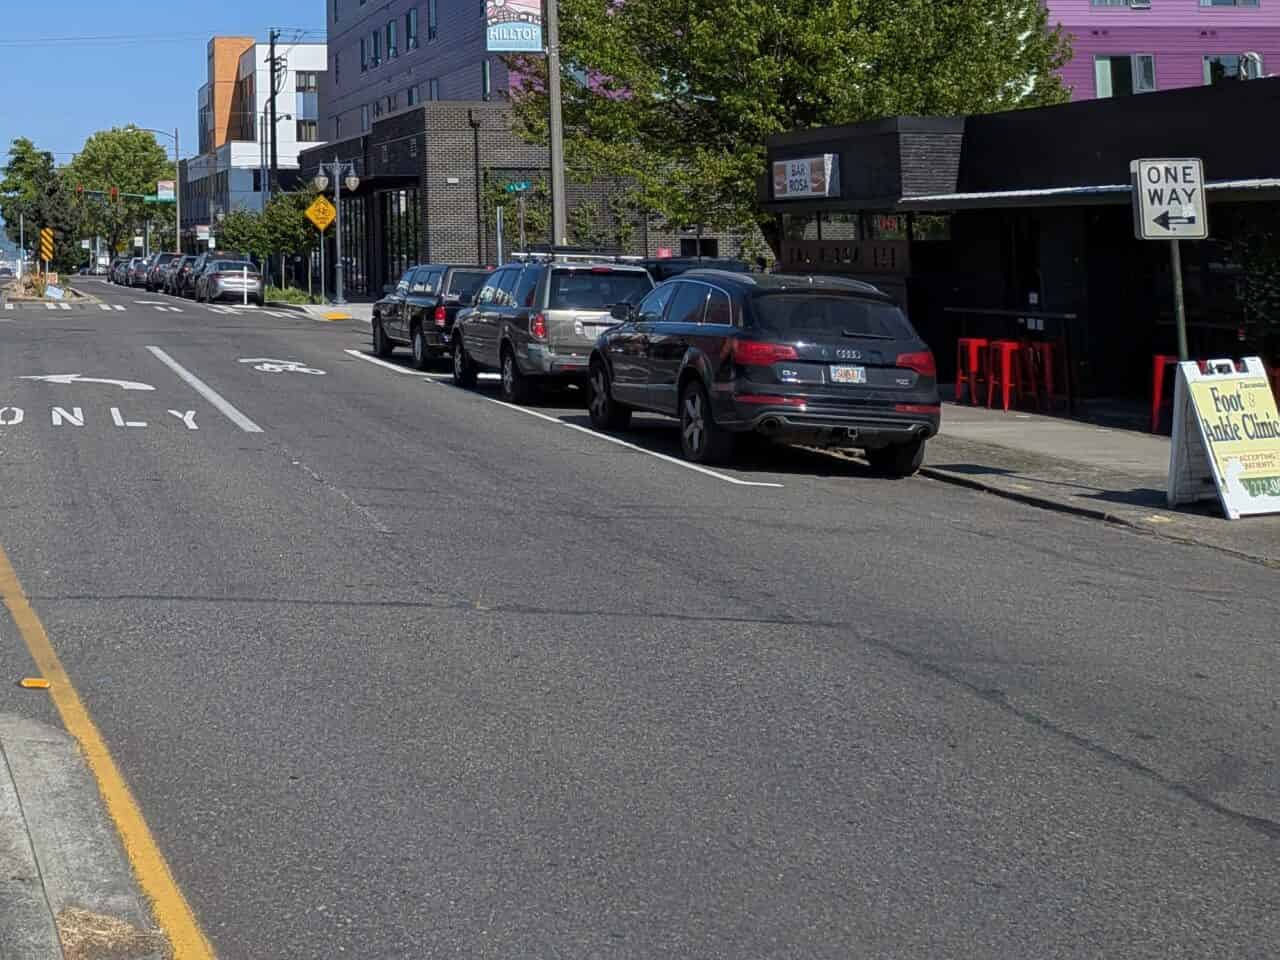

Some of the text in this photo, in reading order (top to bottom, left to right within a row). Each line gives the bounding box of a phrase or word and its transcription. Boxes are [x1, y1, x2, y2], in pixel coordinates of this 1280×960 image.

[489, 27, 537, 41] HILLTOP
[791, 162, 807, 176] BAR
[1147, 166, 1195, 184] ONE
[789, 178, 809, 192] ROSA
[1148, 188, 1196, 206] WAY
[1210, 387, 1245, 413] Foot
[1203, 412, 1280, 442] Ankle Clinic
